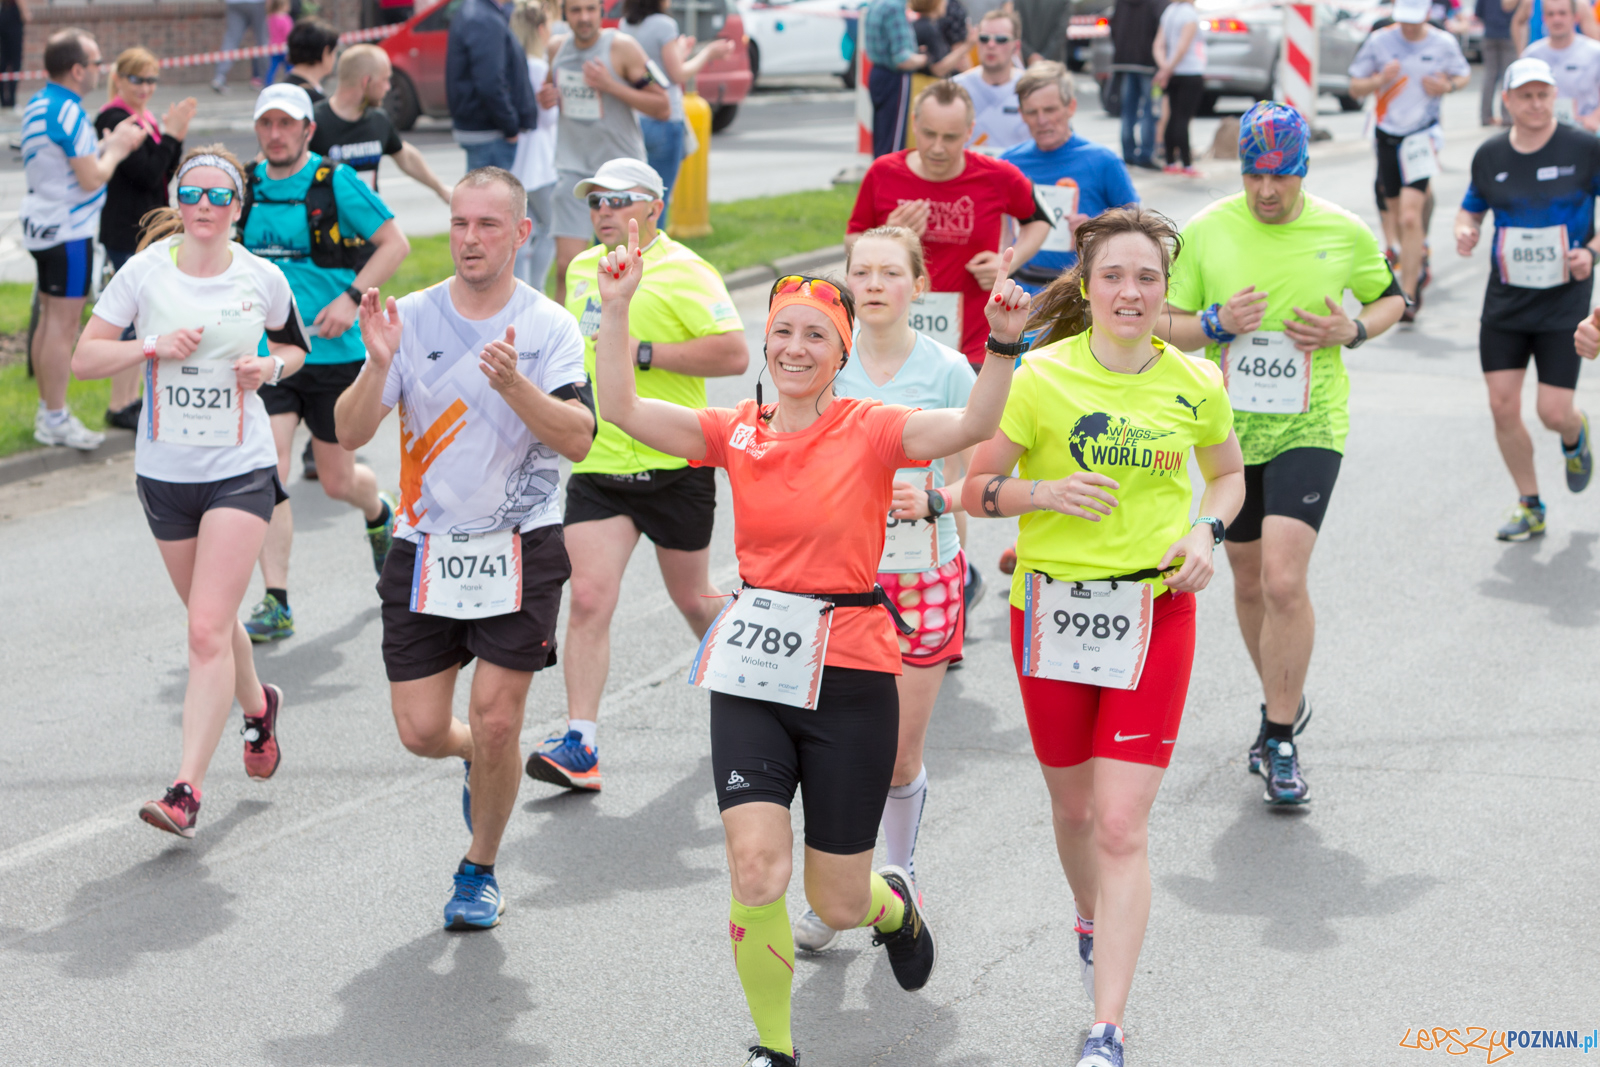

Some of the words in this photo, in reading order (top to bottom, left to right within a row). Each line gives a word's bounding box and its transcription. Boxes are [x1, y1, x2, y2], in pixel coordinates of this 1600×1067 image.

[1513, 247, 1556, 262] 8853
[1237, 356, 1297, 378] 4866
[165, 385, 231, 409] 10321
[183, 412, 212, 421] Marlena
[1109, 425, 1152, 439] WINGS
[1114, 437, 1140, 447] LIFE
[1091, 445, 1153, 468] WORLD
[1153, 449, 1183, 471] RUN
[437, 554, 507, 579] 10741
[1053, 609, 1131, 641] 9989
[726, 619, 802, 658] 2789
[1082, 643, 1101, 653] Ewa
[741, 655, 778, 670] Wioletta
[725, 782, 750, 791] odlo
